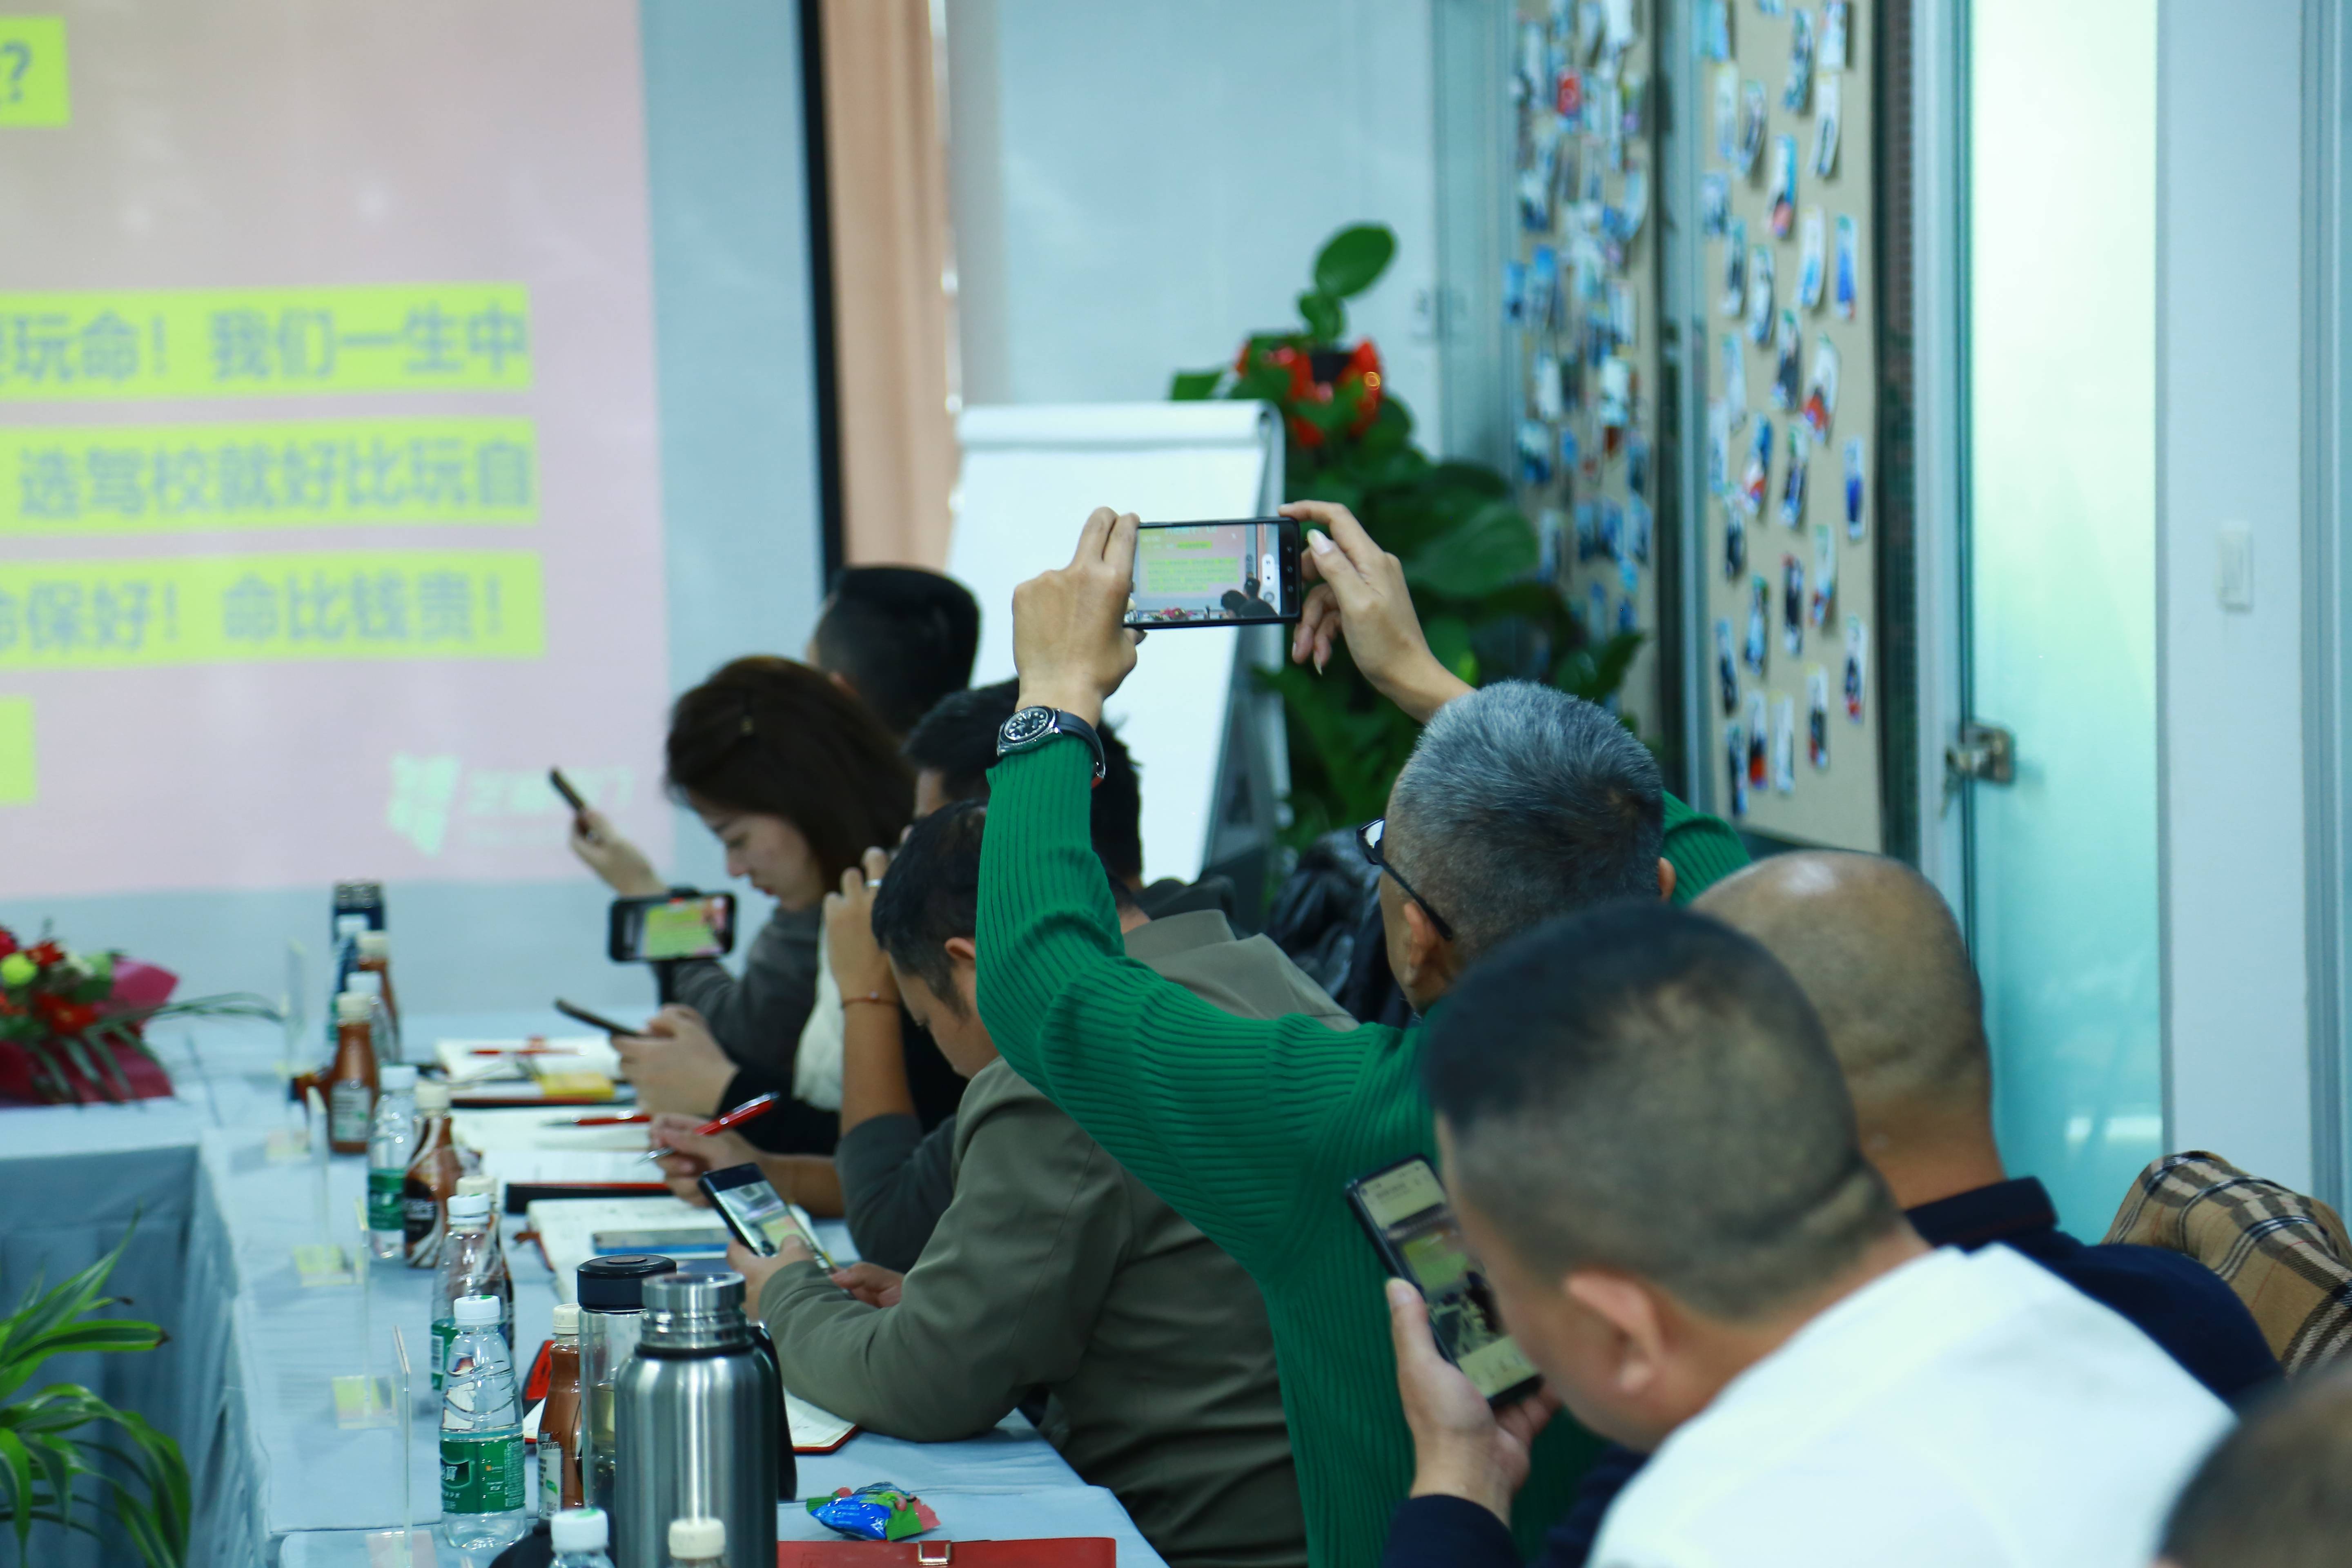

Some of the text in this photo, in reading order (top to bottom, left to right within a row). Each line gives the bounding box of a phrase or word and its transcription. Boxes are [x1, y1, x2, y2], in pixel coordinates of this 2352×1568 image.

[0, 299, 526, 385] 玩命！我们一生中
